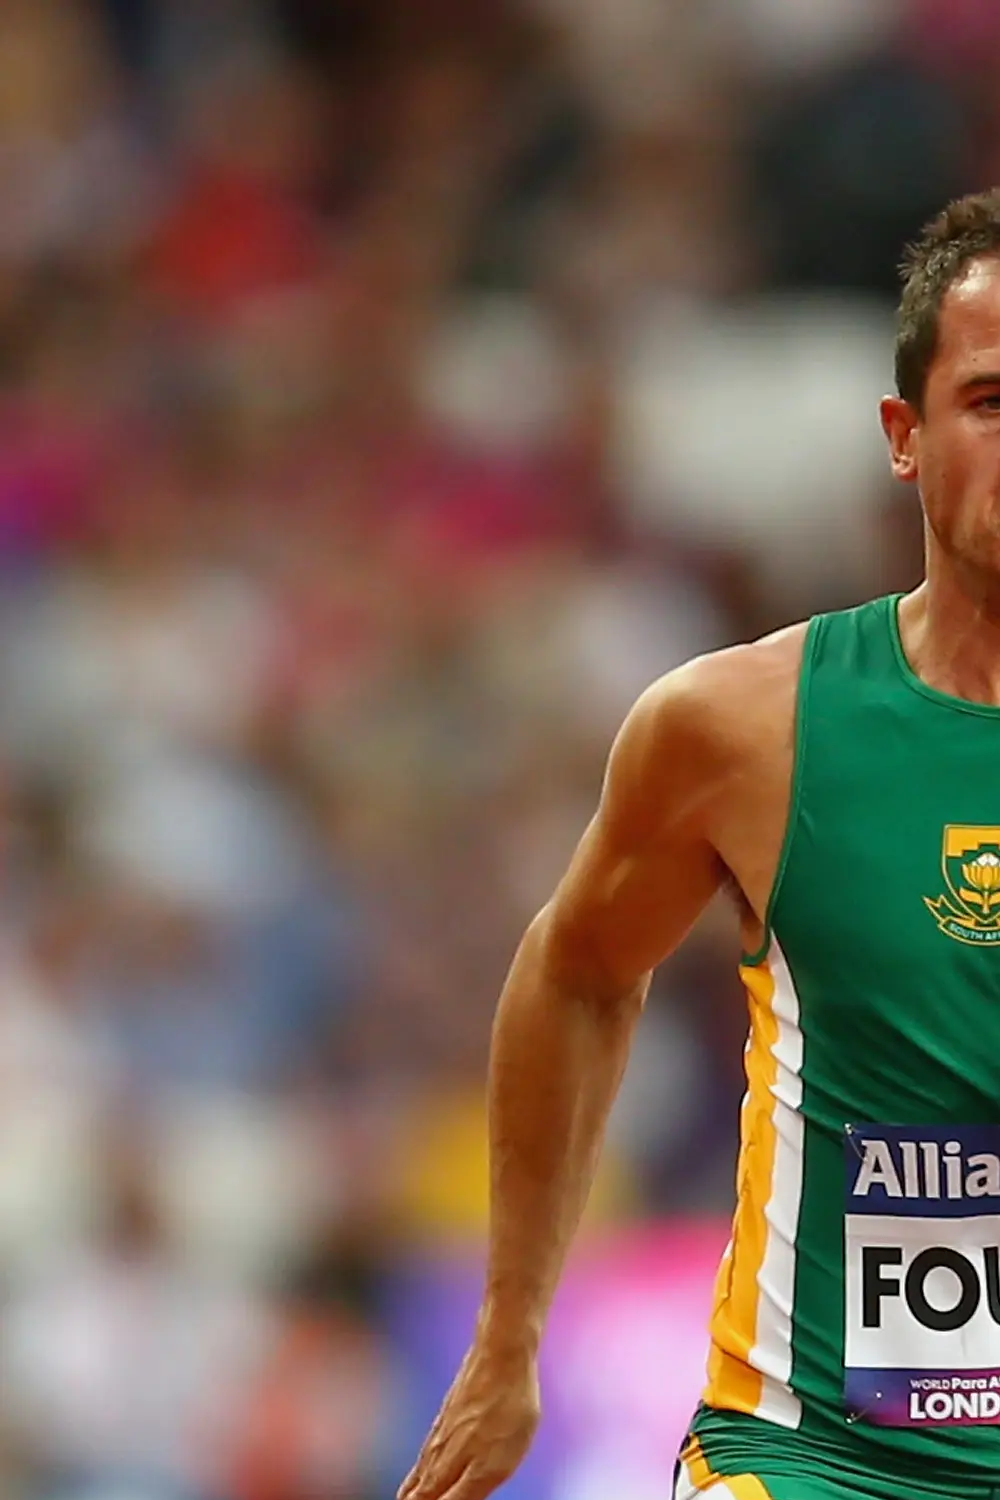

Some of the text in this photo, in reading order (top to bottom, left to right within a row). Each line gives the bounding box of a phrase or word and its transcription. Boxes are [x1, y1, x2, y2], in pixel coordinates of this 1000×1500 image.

[949, 922, 983, 940] SOUTH
[910, 1378, 950, 1390] WORLD
[951, 1377, 987, 1390] Para
